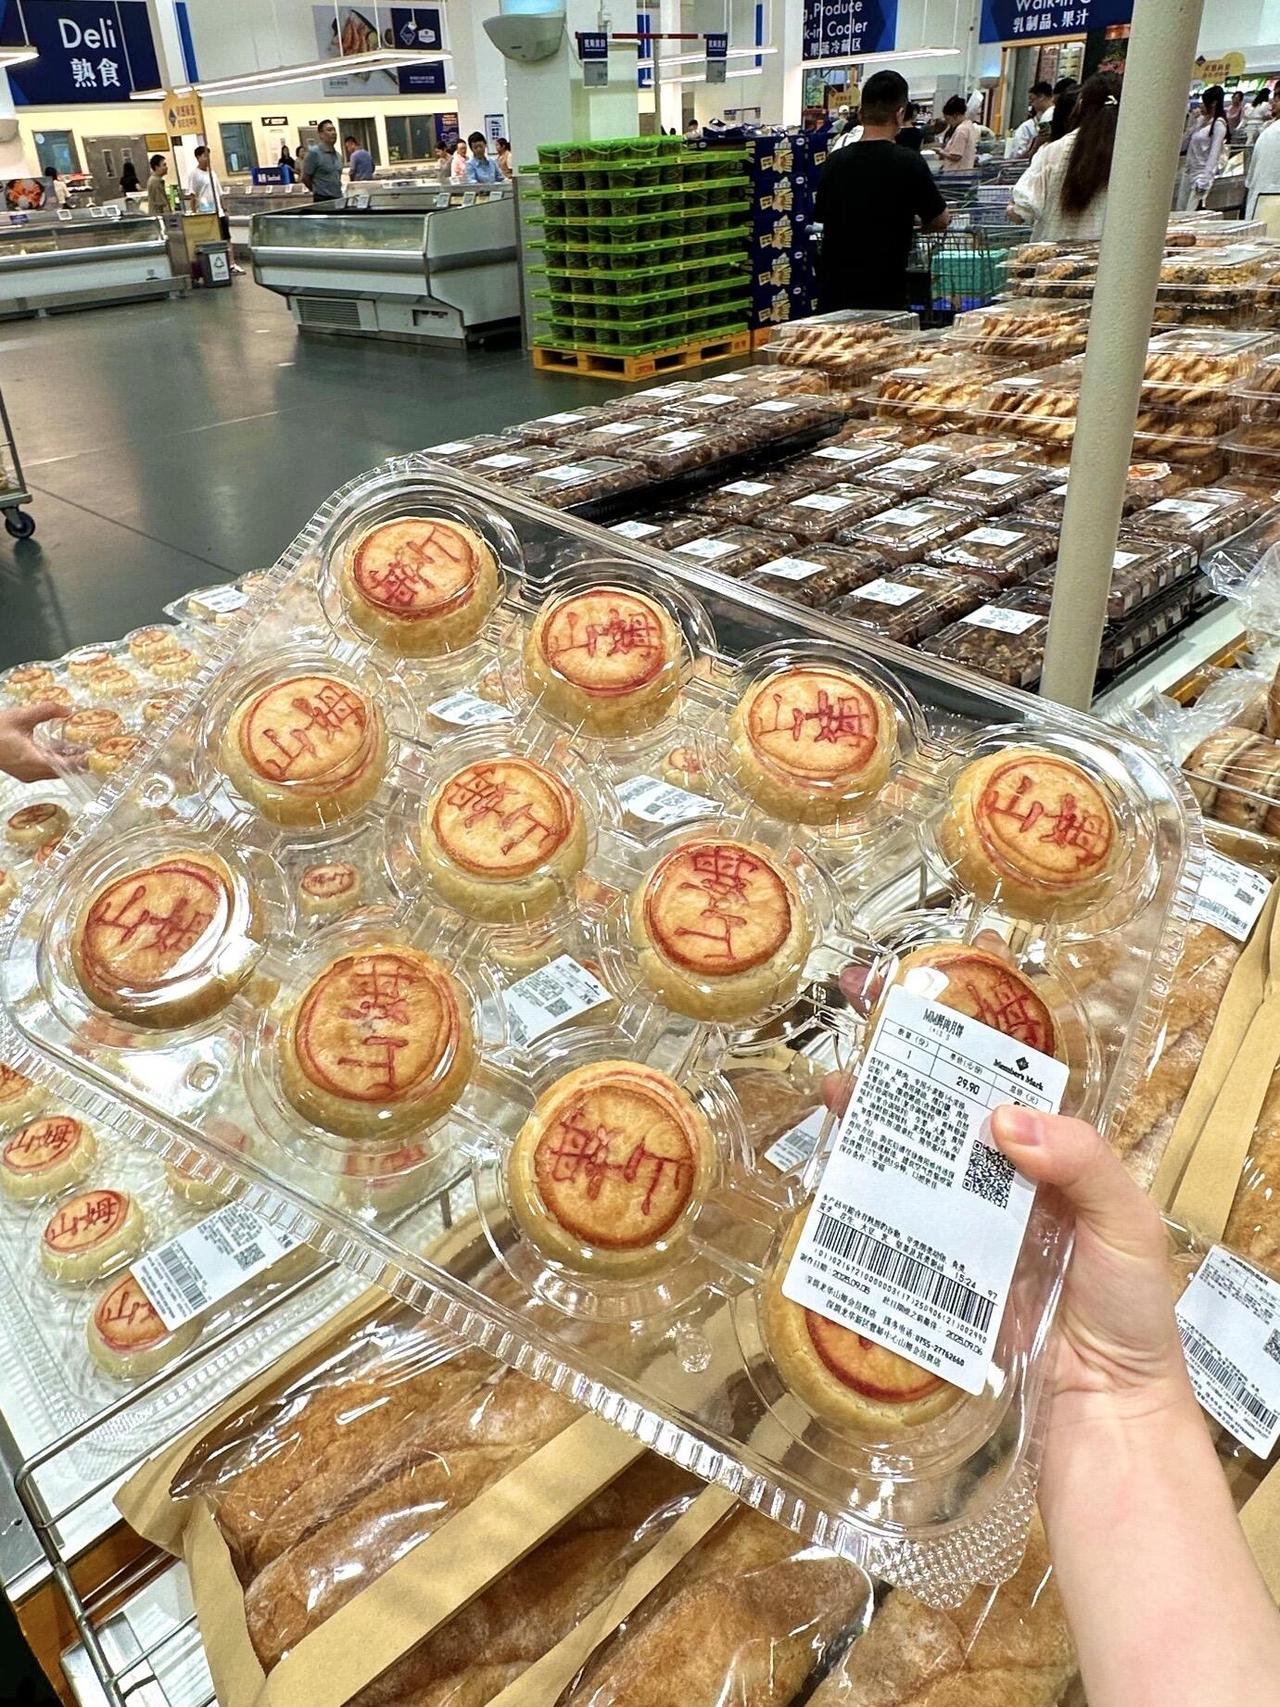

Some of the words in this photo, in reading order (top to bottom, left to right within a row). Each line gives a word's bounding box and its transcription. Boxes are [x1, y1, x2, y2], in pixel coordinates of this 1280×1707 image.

[58, 18, 117, 49] Deli
[826, 18, 868, 37] Cooler
[1012, 8, 1089, 33] 乳制品、果汁
[70, 58, 121, 88] 熟食
[955, 1075, 980, 1095] 29.90
[992, 1058, 1024, 1081] Member's
[1025, 1075, 1044, 1091] Mark
[954, 1271, 977, 1289] 15:24
[986, 1288, 998, 1301] 97
